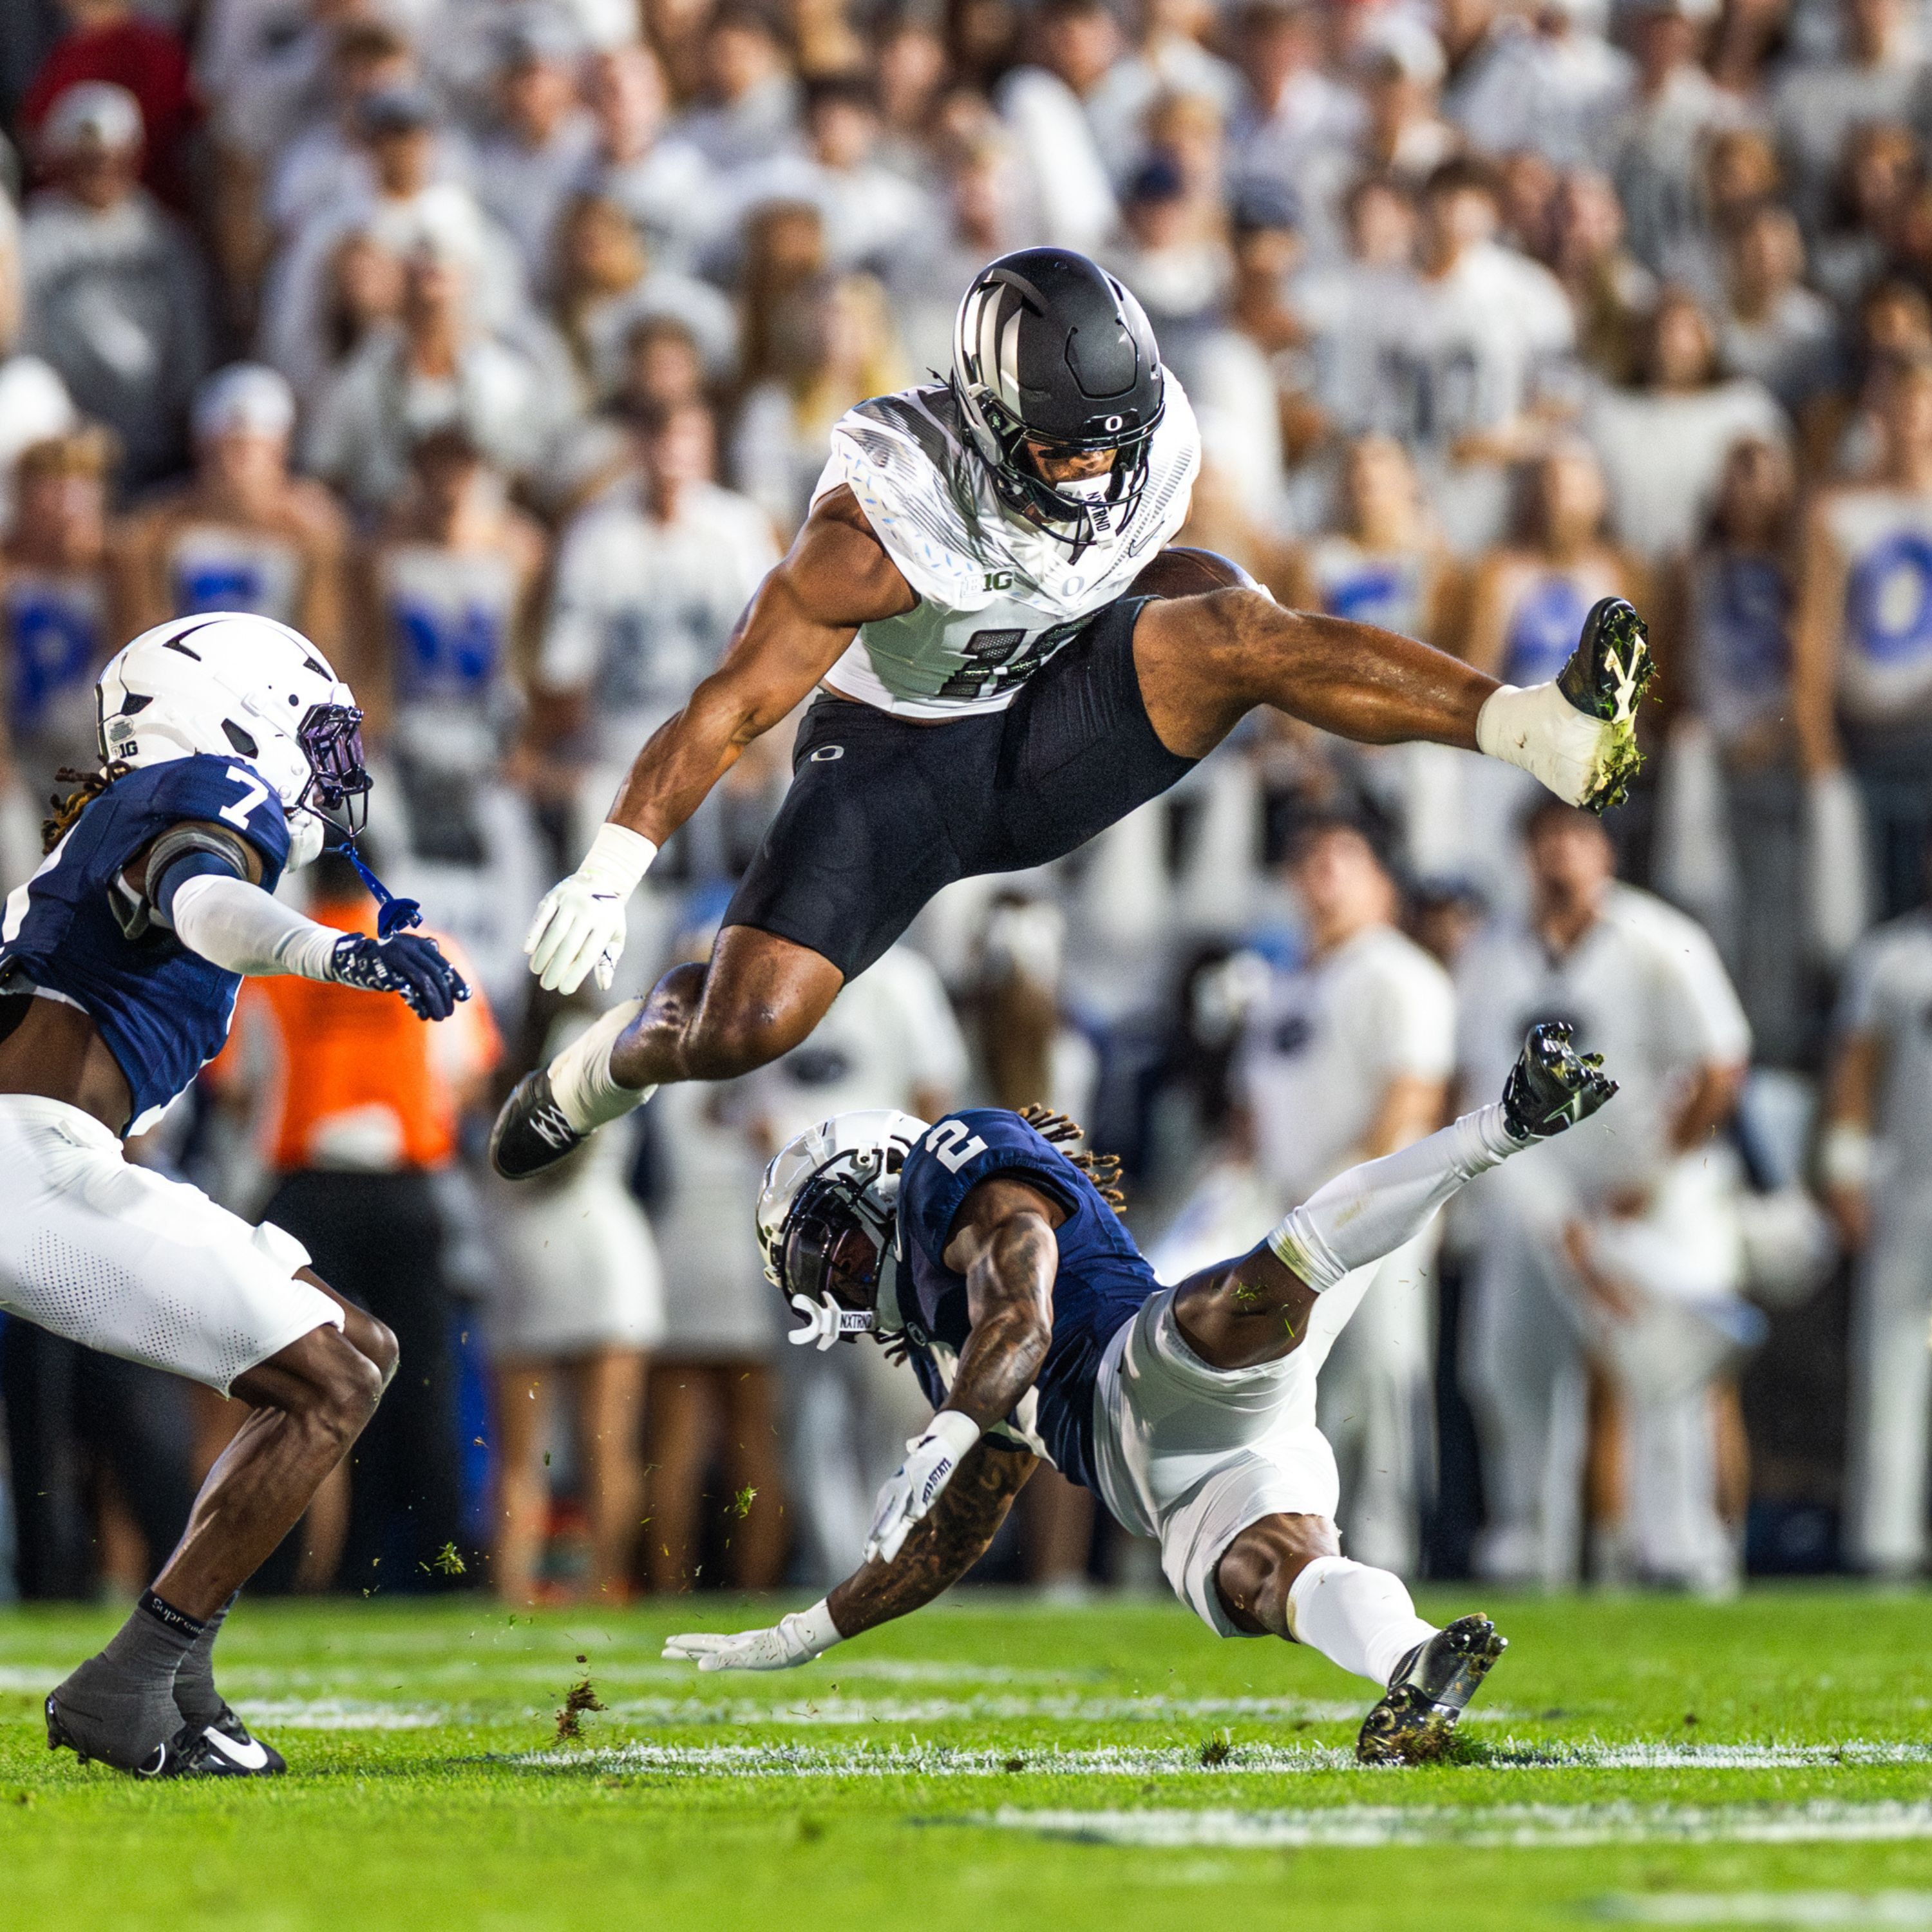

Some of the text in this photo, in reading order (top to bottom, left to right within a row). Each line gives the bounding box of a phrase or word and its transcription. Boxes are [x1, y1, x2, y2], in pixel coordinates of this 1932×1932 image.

[1105, 415, 1122, 431] O
[218, 764, 269, 831] 7
[925, 1119, 989, 1174] 2
[839, 1313, 873, 1329] NXTRND
